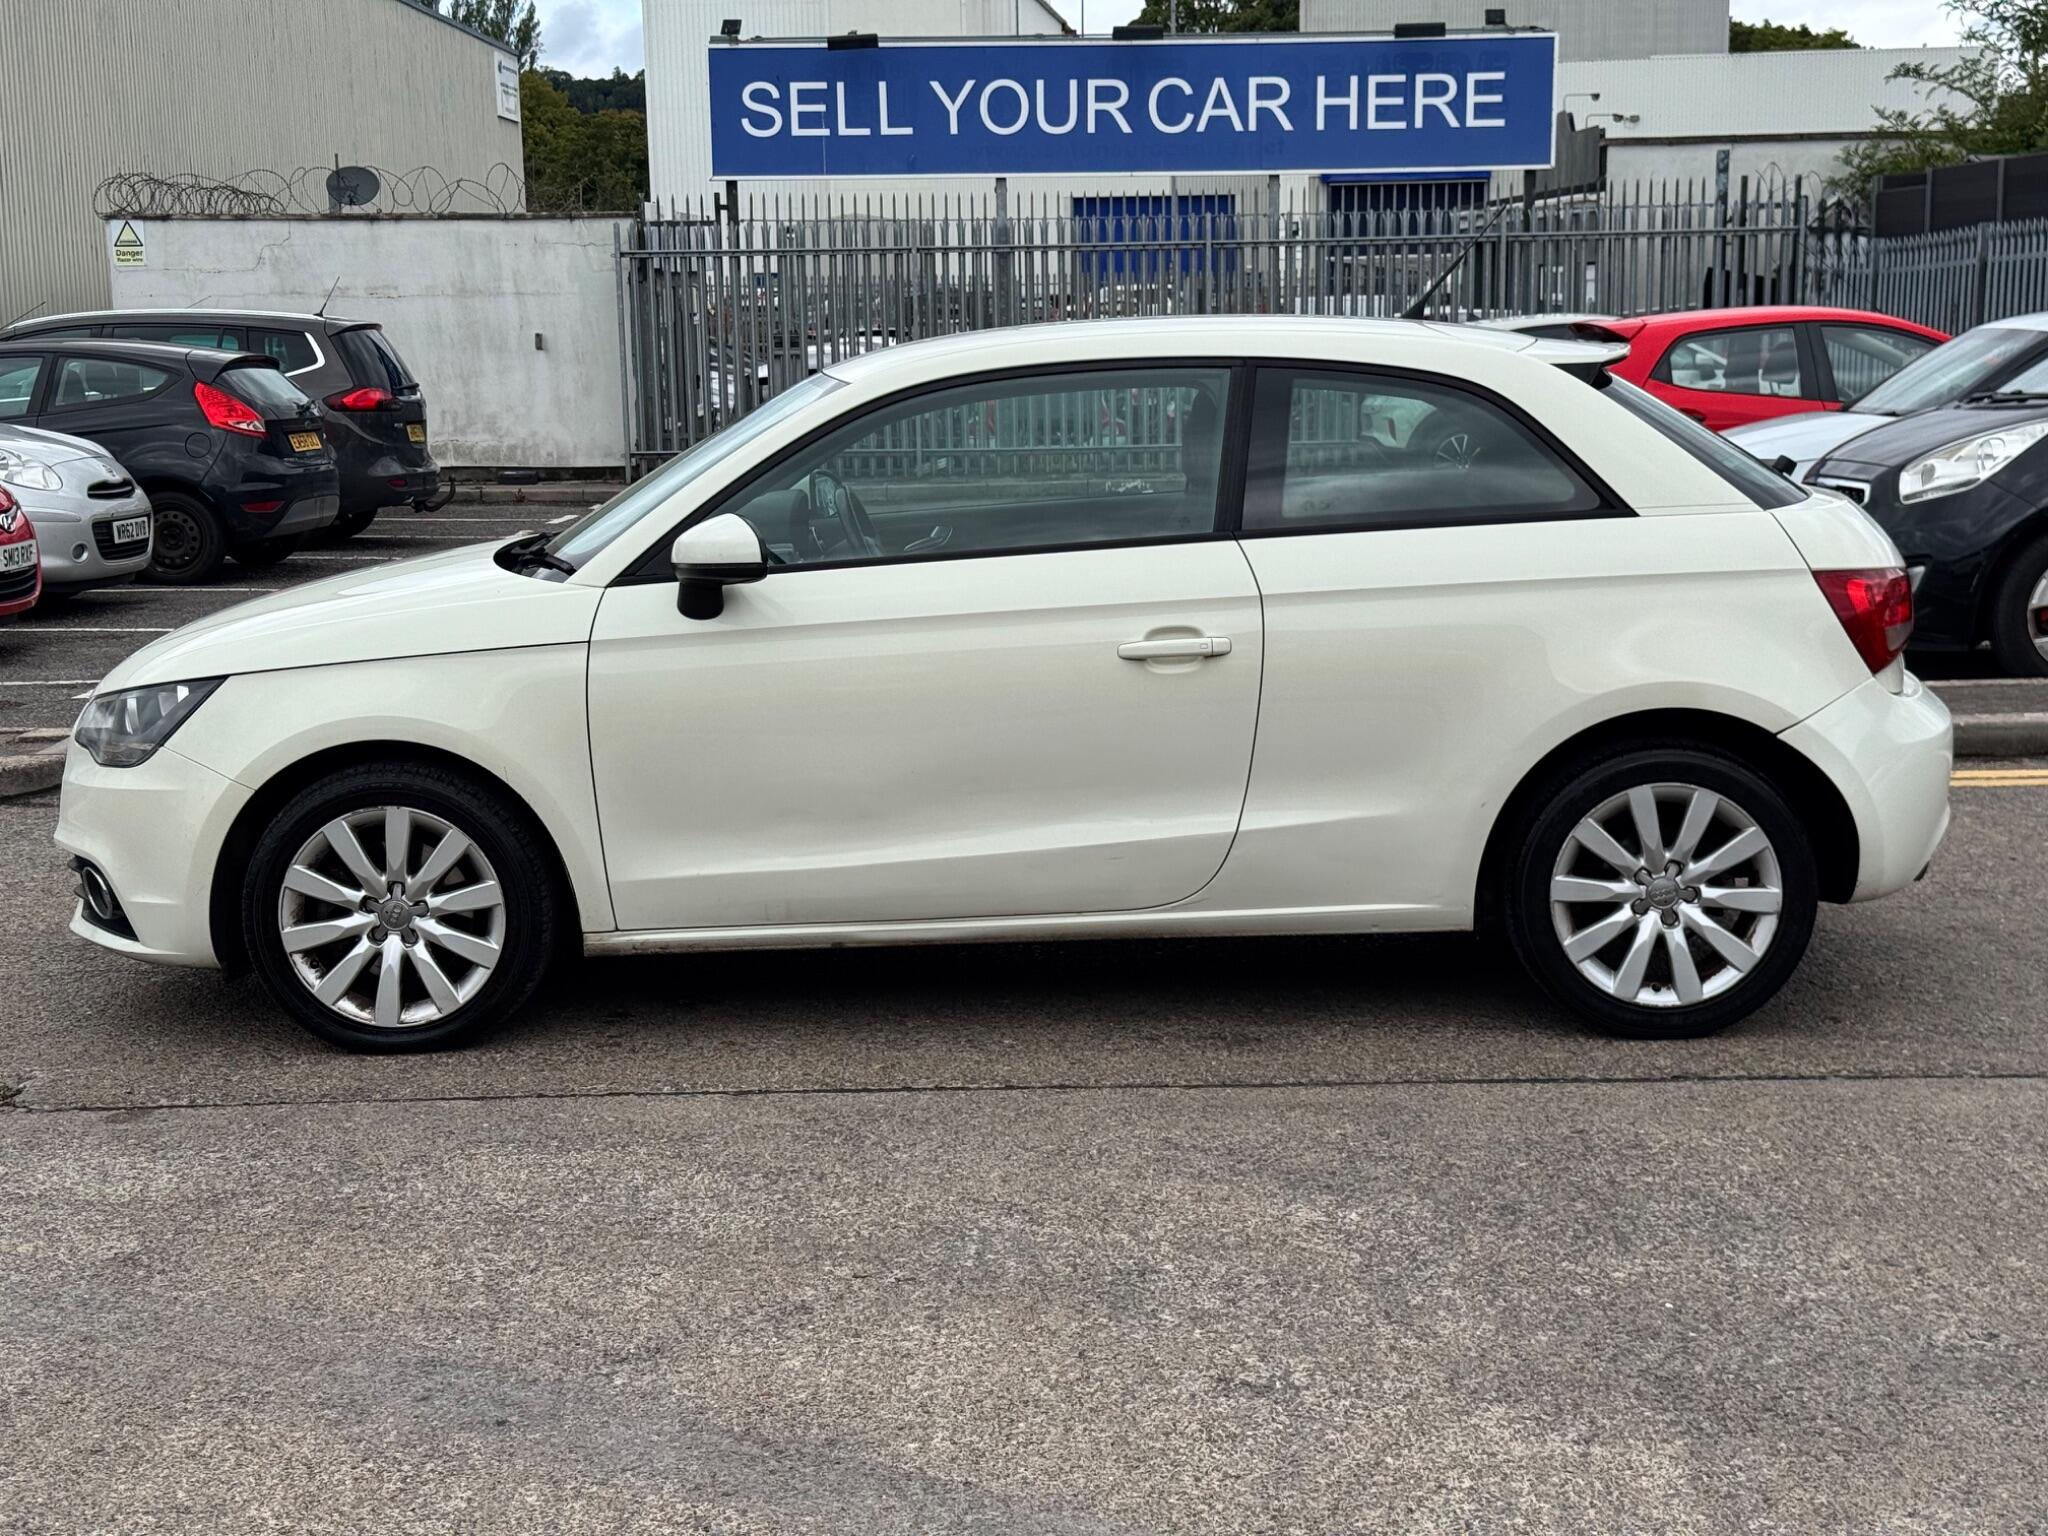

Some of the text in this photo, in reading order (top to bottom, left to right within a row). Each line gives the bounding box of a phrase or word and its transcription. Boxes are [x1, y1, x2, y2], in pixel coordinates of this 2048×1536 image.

[741, 71, 1506, 138] SELL YOUR CAR HERE
[115, 249, 143, 257] Danger
[3, 546, 20, 567] SM13
